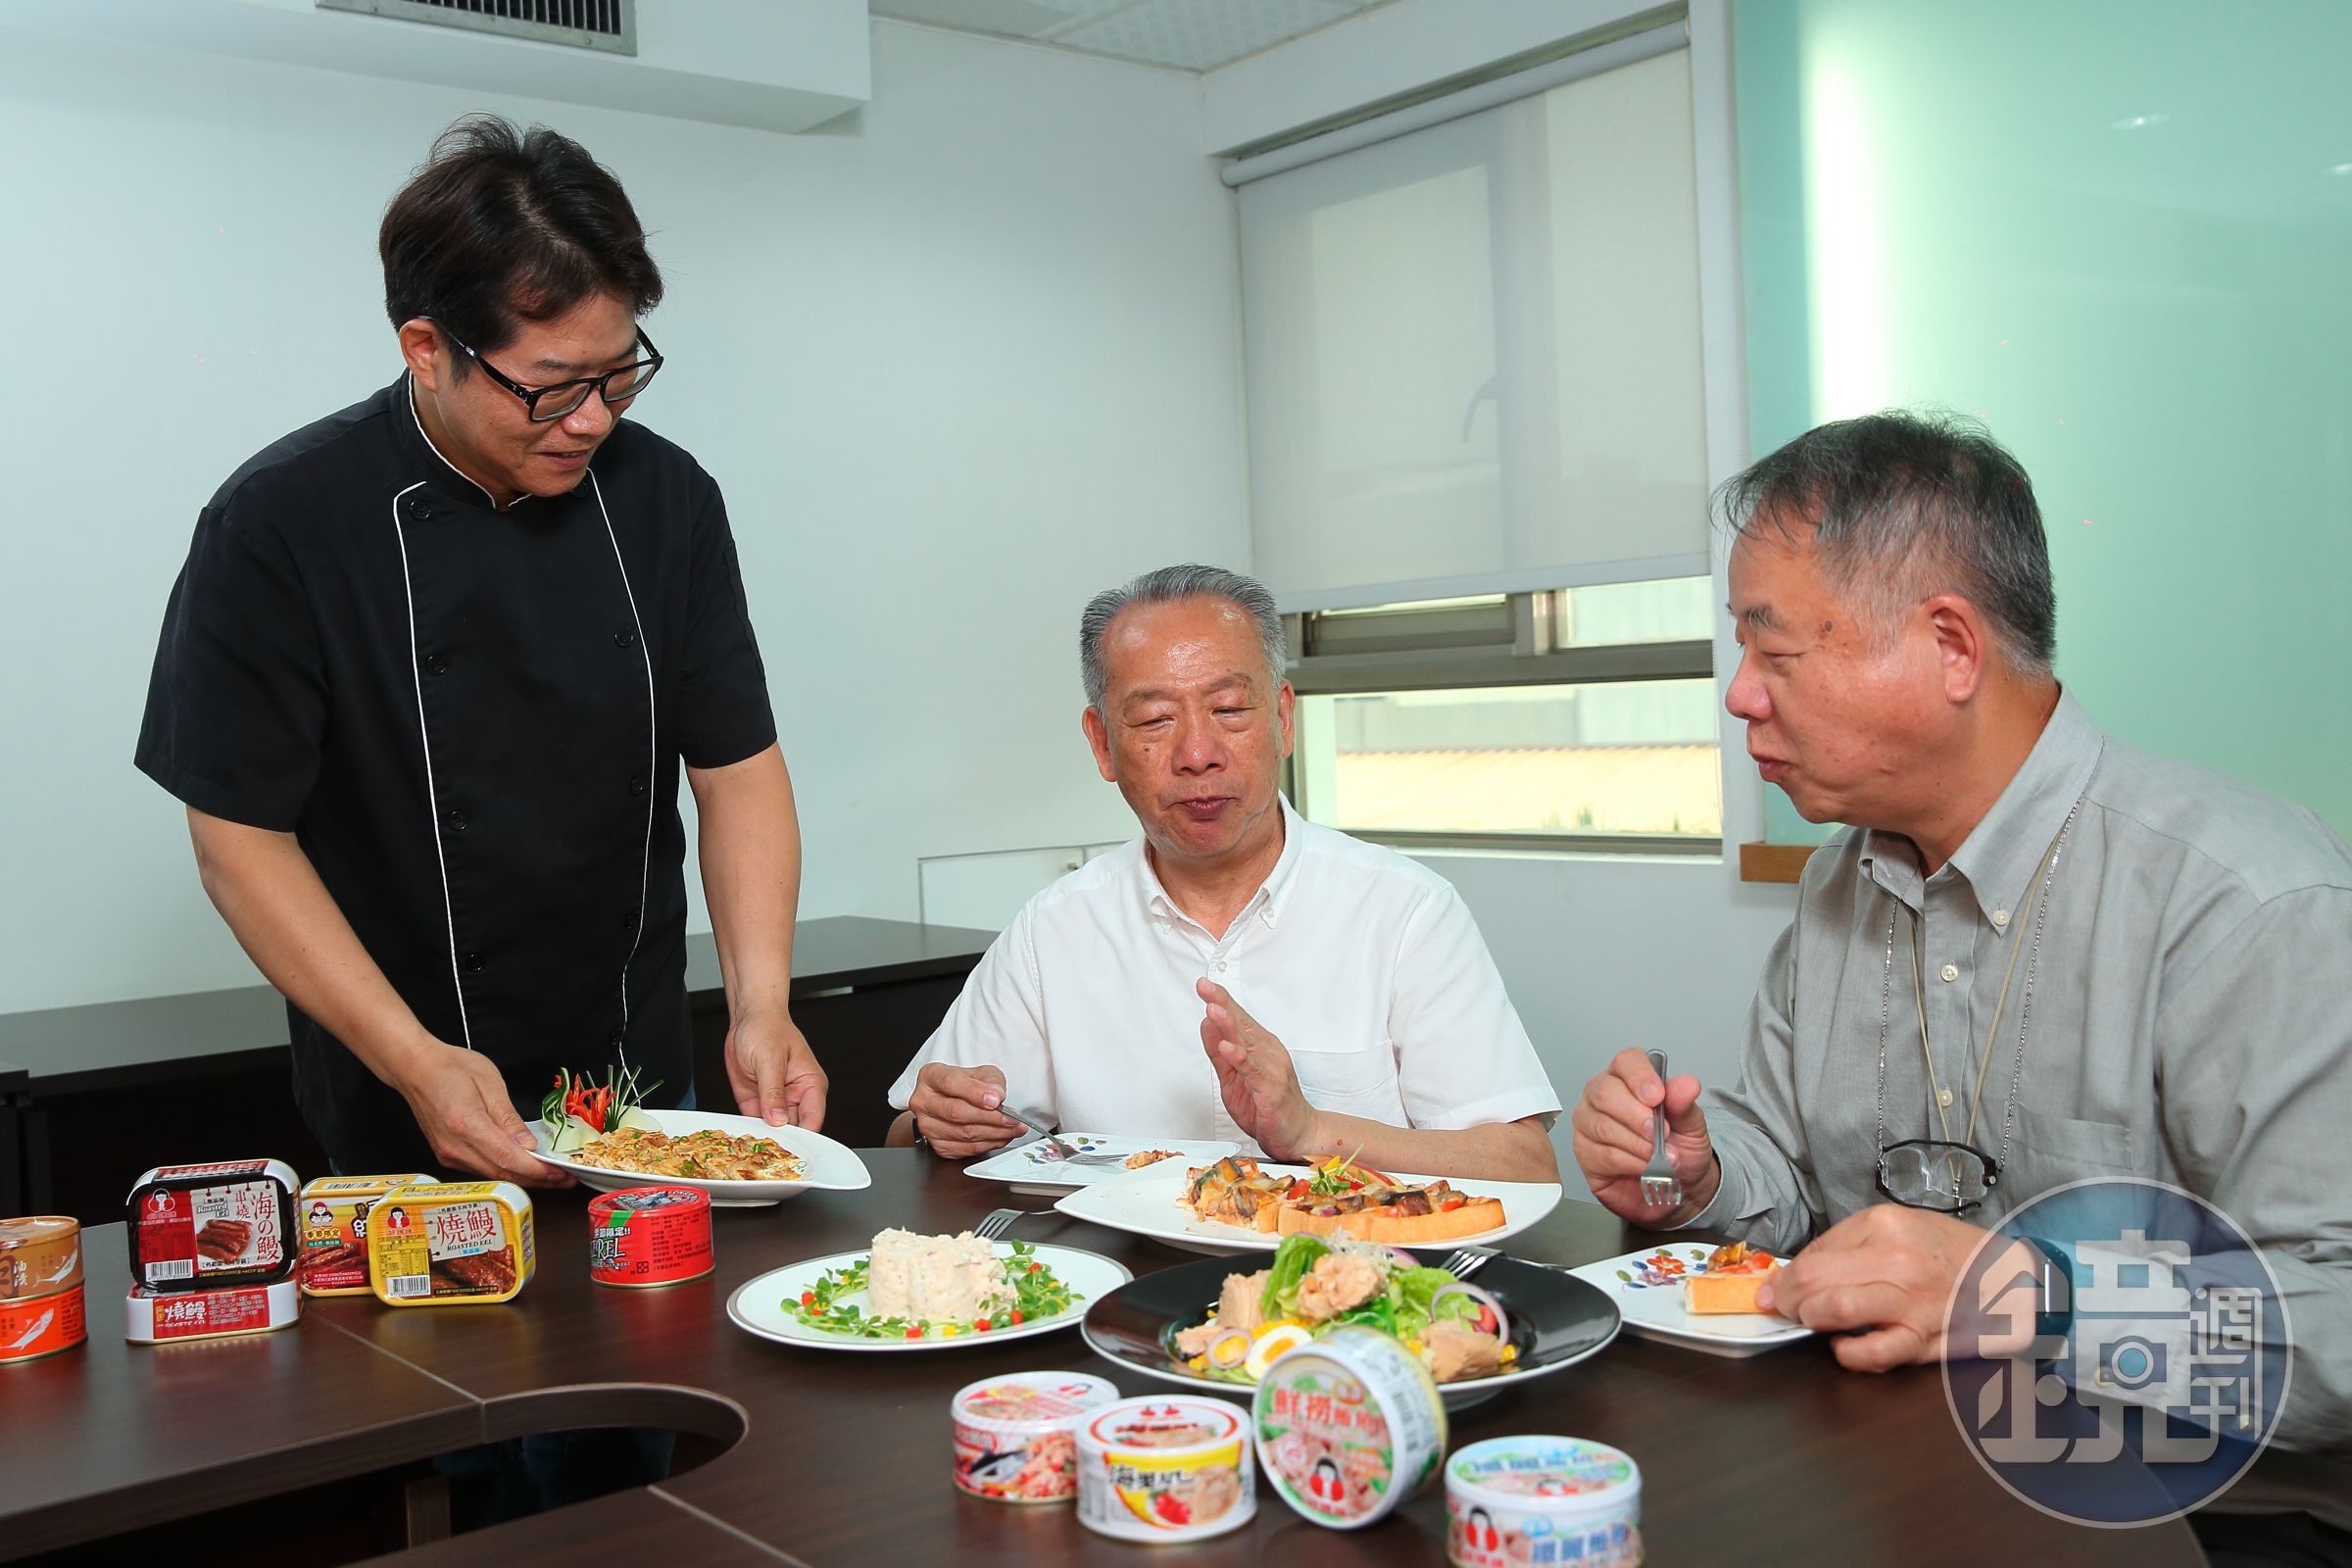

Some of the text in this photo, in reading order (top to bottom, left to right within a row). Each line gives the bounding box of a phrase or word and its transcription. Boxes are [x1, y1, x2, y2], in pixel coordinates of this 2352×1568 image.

[197, 1203, 227, 1214] Roasted
[235, 1191, 251, 1219] 串燒
[216, 1209, 229, 1218] Eel
[251, 1191, 280, 1261] 海の鰻
[307, 1229, 339, 1239] 季節限定
[437, 1207, 497, 1247] 燒鰻
[447, 1242, 478, 1251] ROASTED
[164, 1300, 208, 1321] 燒鰻
